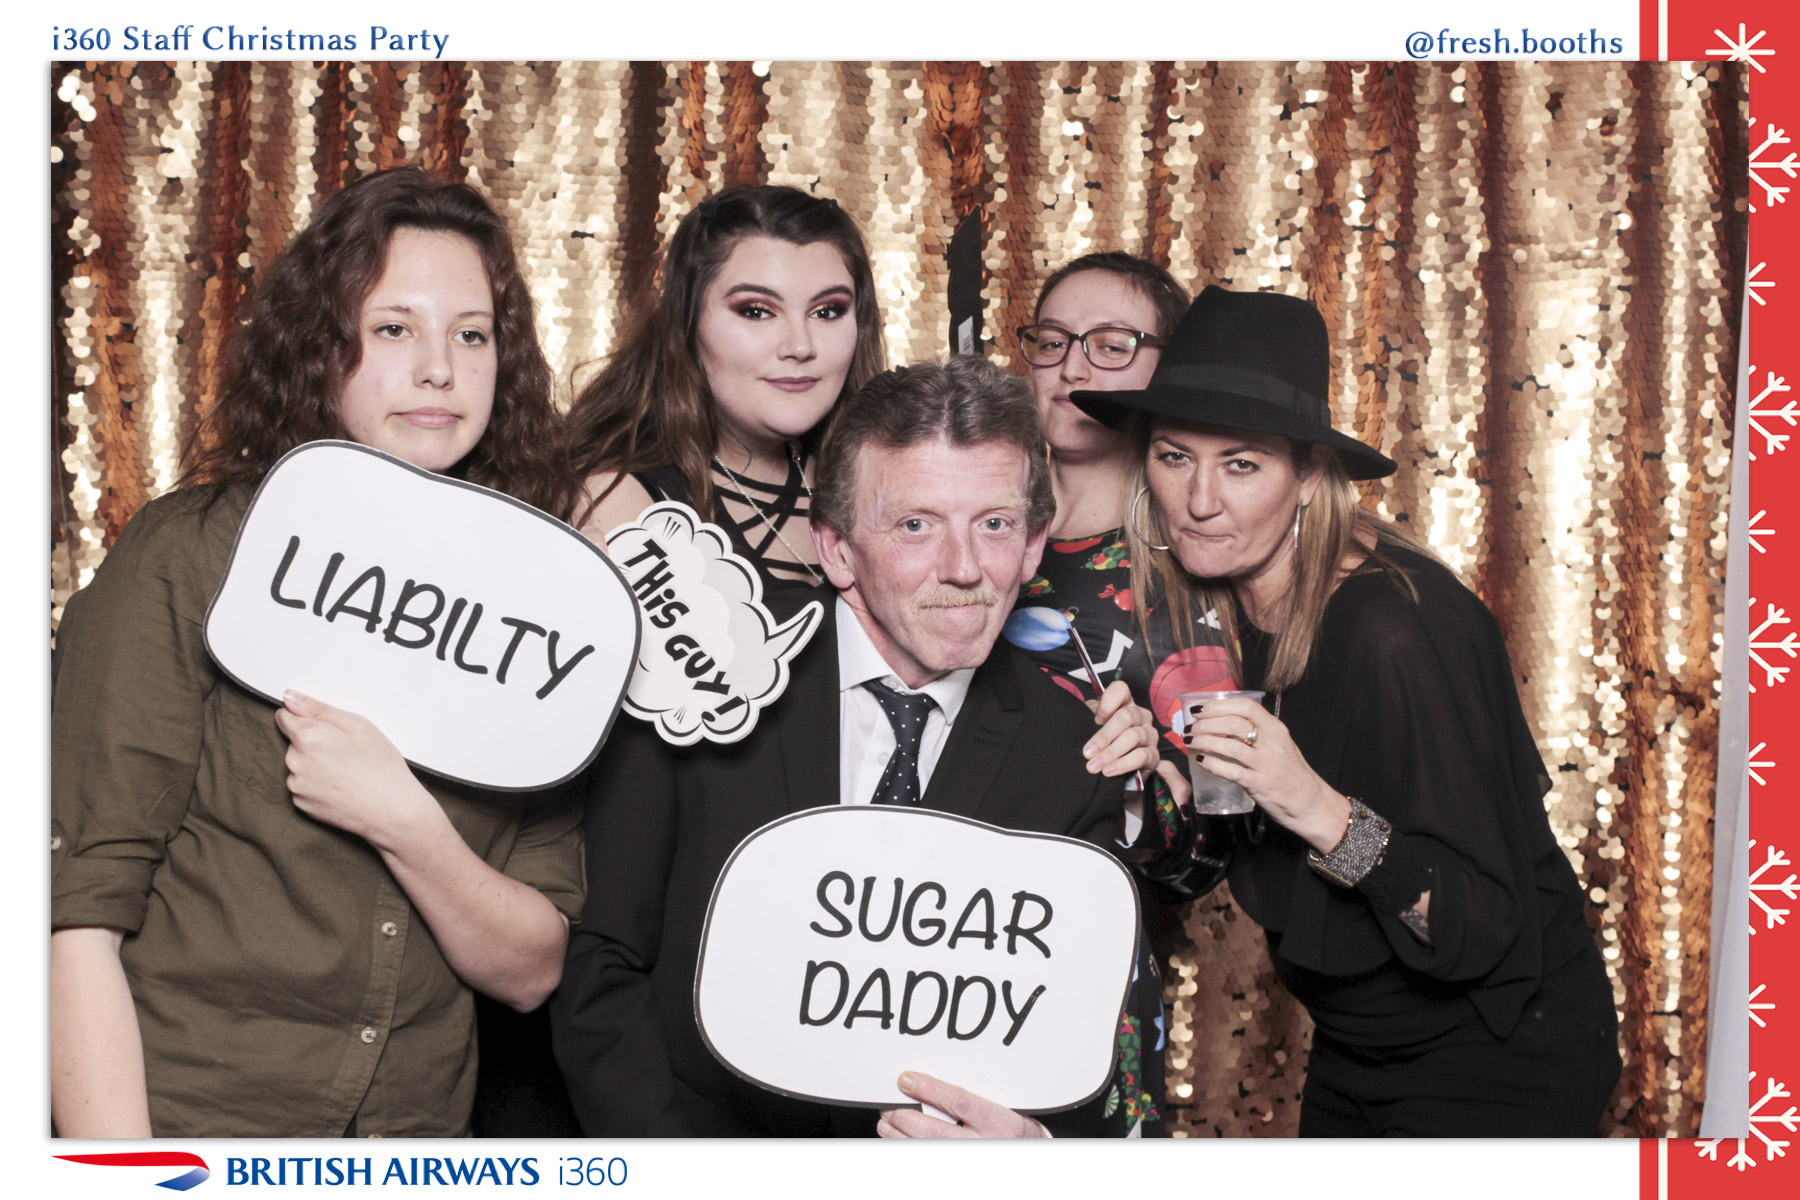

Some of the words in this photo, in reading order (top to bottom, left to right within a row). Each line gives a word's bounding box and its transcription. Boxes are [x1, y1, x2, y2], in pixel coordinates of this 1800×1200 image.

[270, 535, 595, 700] LIABILTY
[664, 634, 748, 723] GUY!
[809, 870, 1053, 959] SUGAR
[799, 960, 1047, 1047] DADDY
